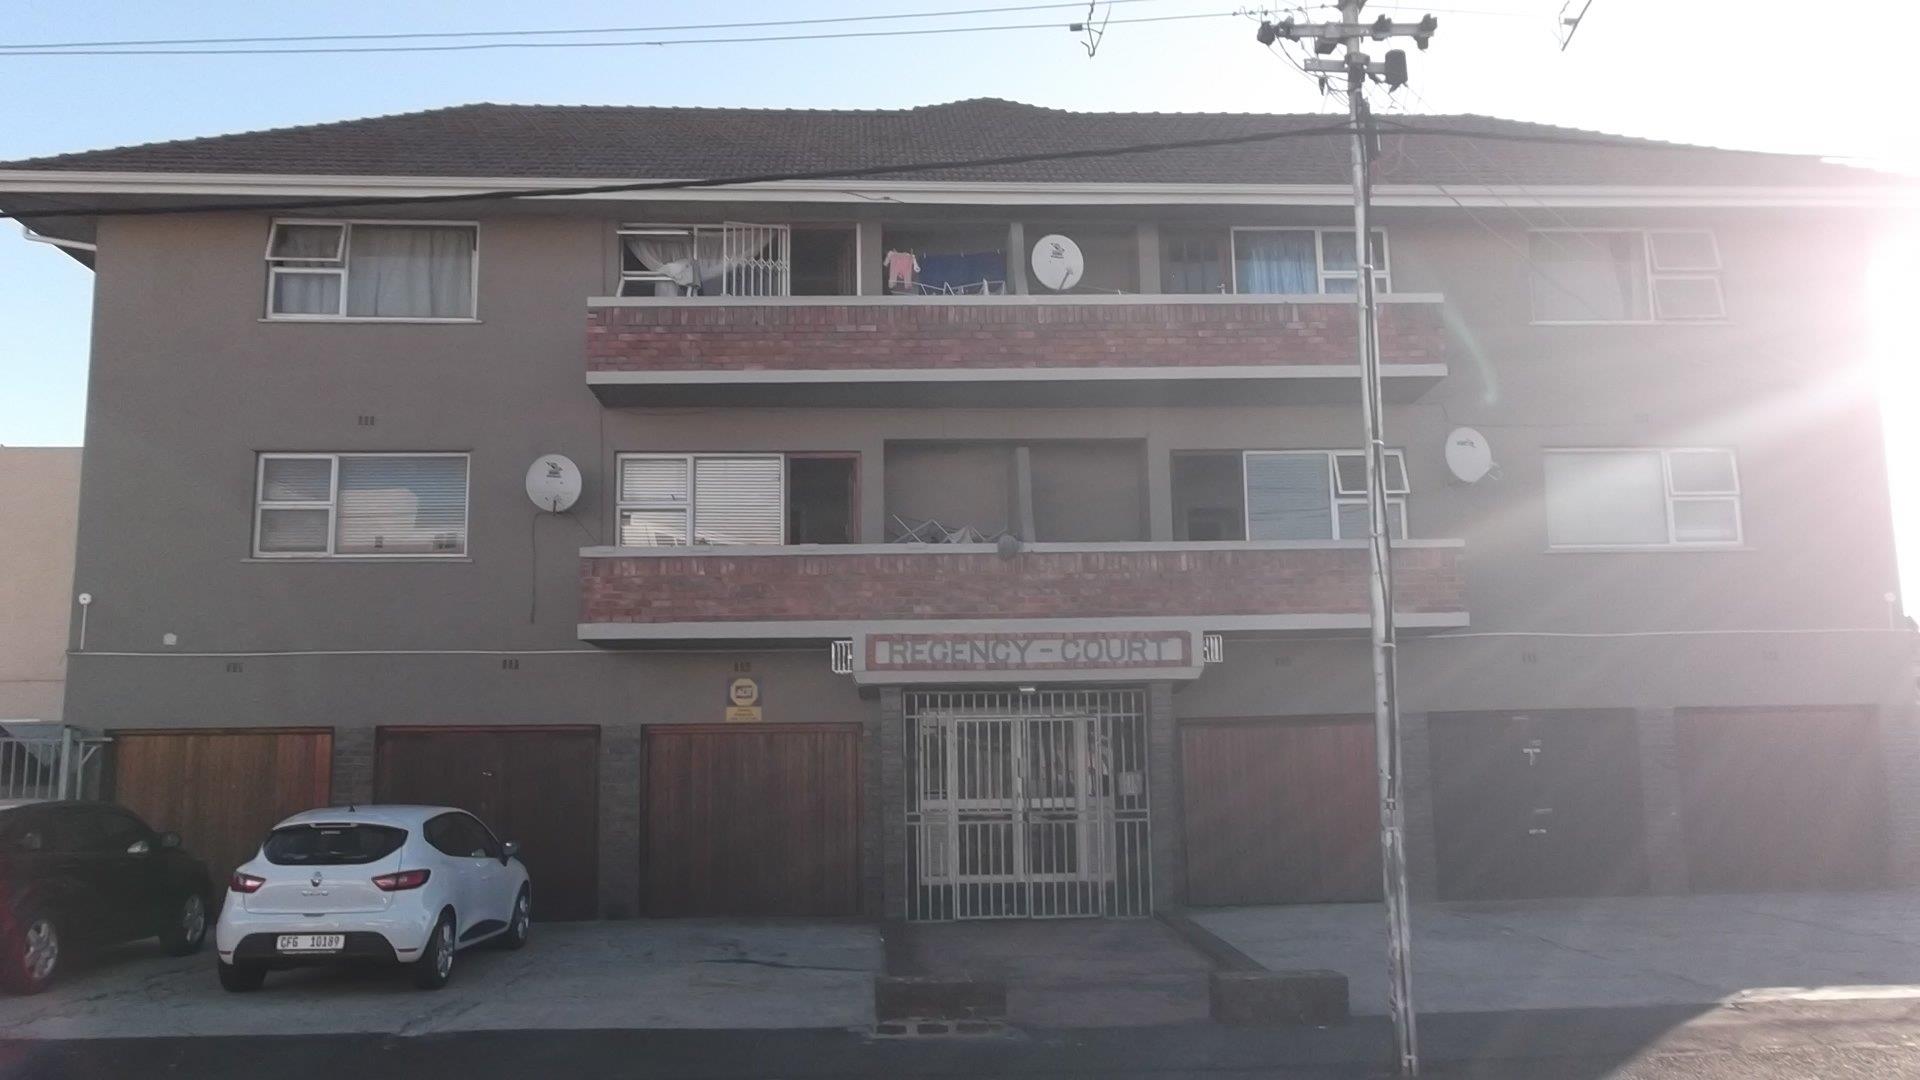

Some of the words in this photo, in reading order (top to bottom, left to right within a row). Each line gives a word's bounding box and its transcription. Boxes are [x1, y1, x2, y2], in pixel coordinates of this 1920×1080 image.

[889, 640, 1034, 662] REGENCY
[1061, 639, 1169, 661] COURT
[310, 936, 340, 948] 10189
